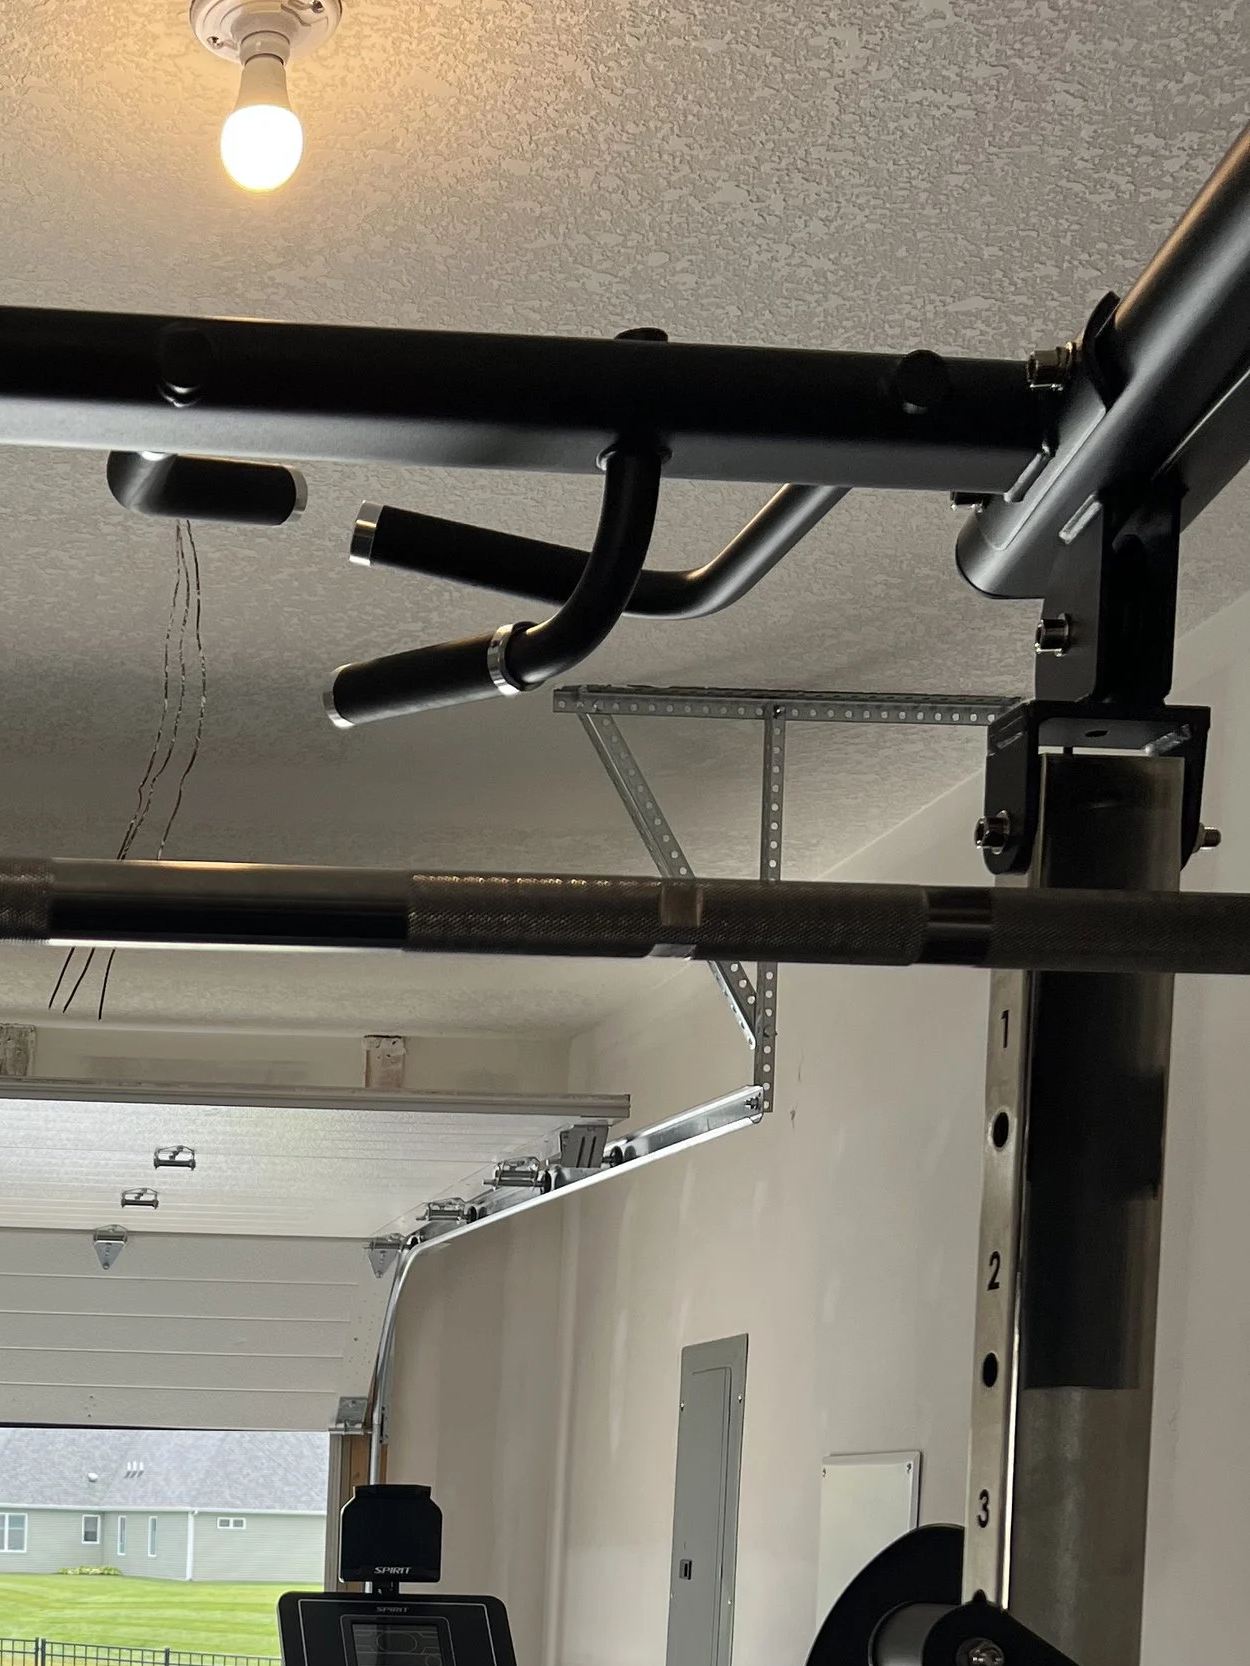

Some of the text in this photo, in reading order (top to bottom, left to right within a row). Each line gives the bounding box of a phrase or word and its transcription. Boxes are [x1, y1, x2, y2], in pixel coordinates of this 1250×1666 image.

[1000, 1009, 1010, 1049] 1
[986, 1250, 1001, 1291] 2
[976, 1488, 990, 1529] 3
[373, 1565, 413, 1575] SPIRIT
[375, 1605, 411, 1614] SPIRIT
